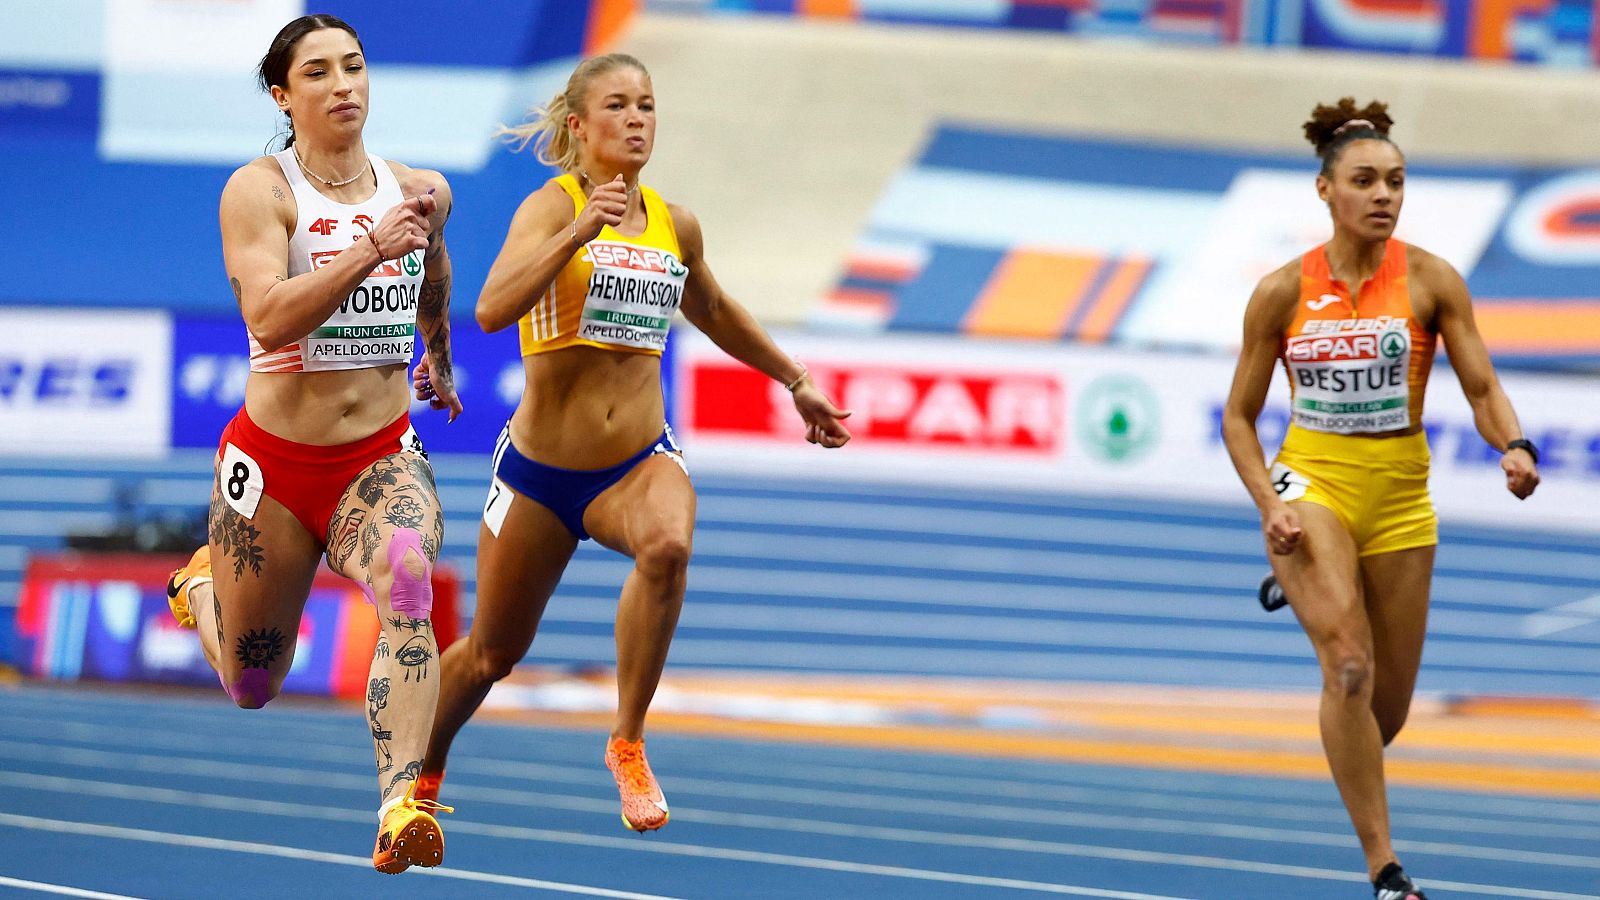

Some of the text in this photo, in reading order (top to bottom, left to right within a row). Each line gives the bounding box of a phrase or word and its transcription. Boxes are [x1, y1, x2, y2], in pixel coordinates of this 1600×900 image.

[309, 217, 338, 236] 4F
[592, 245, 665, 271] SPAR
[339, 283, 417, 314] VOBODA
[590, 273, 681, 308] HENRIKSSON
[344, 326, 370, 337] RUN
[612, 313, 635, 325] RUN
[313, 343, 401, 357] APELDOORN
[1291, 336, 1377, 360] SPAR
[1296, 359, 1402, 392] BESTUÉ
[228, 461, 250, 500] 8
